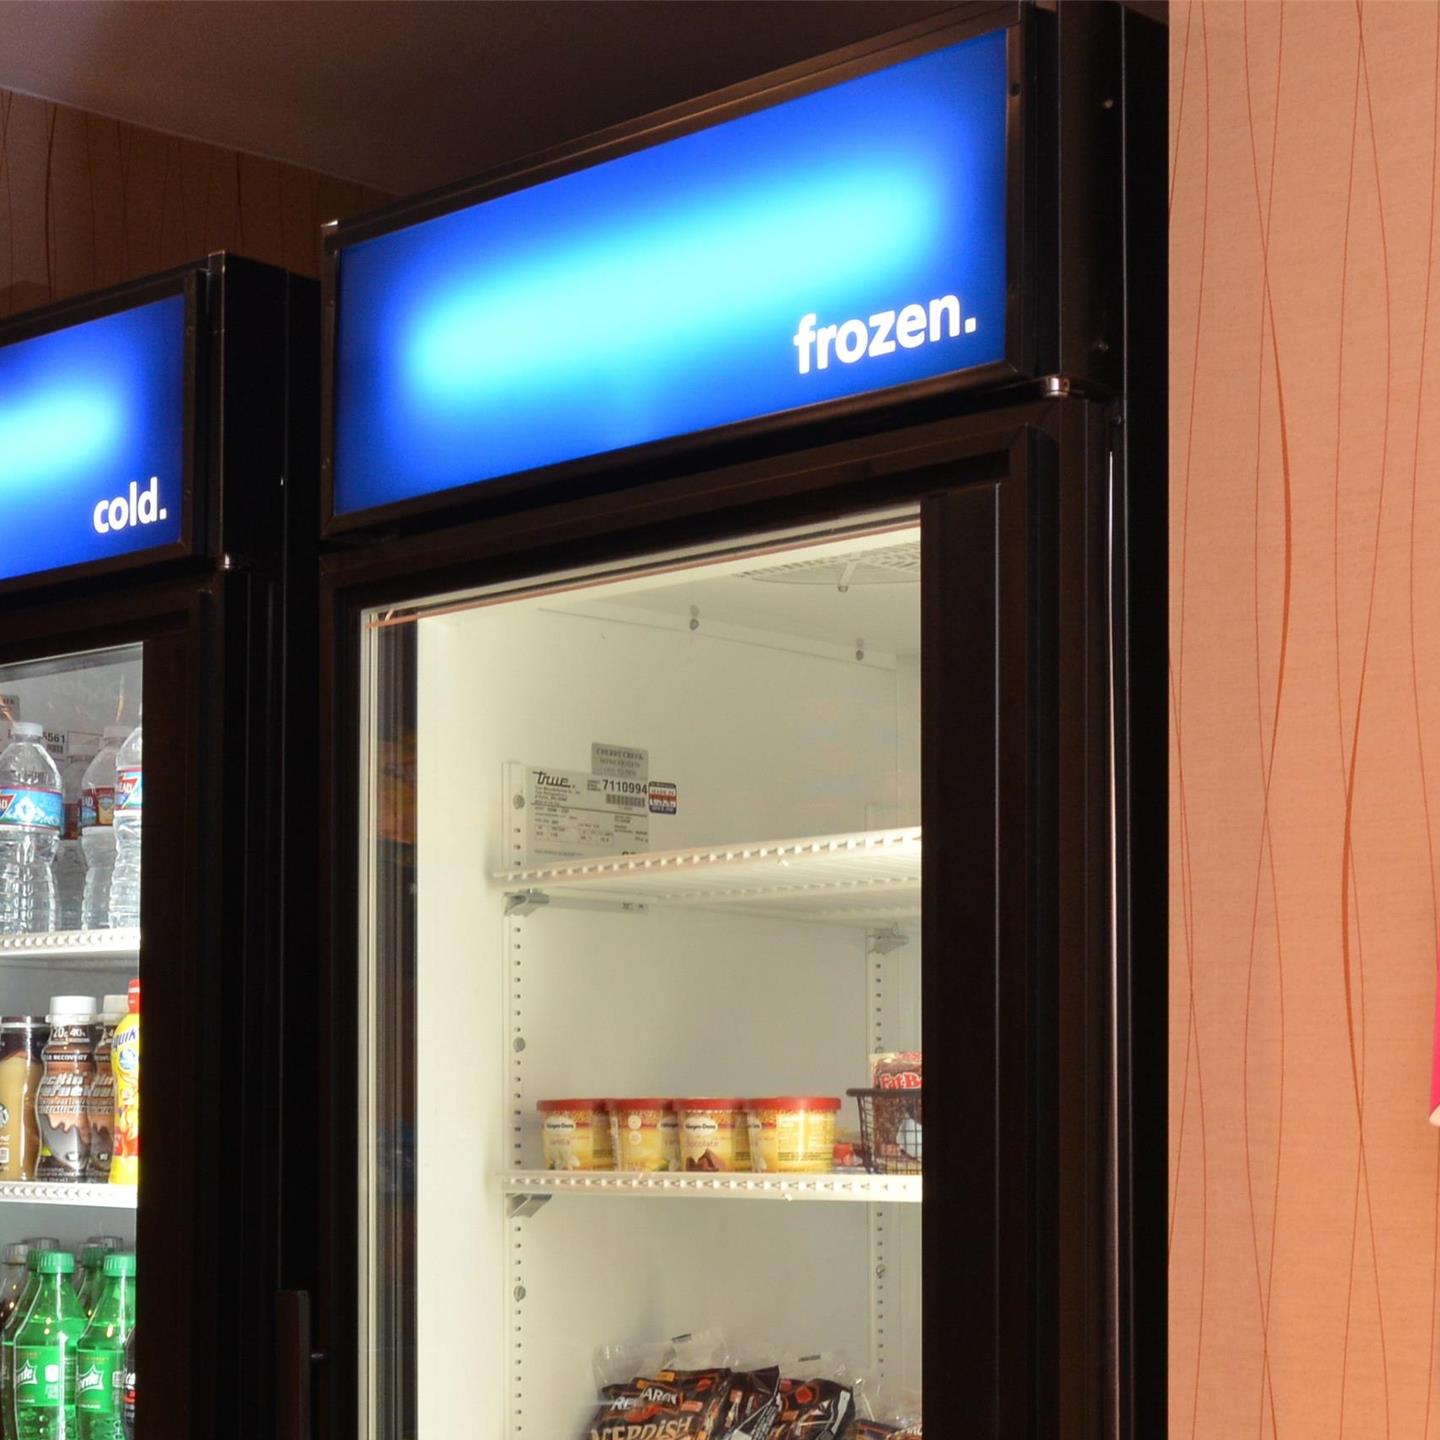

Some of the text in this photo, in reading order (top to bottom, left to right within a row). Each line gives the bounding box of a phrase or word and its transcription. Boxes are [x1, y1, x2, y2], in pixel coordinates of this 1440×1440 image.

[793, 294, 976, 375] frozen.
[93, 476, 167, 534] cold.
[602, 778, 648, 795] 7110994
